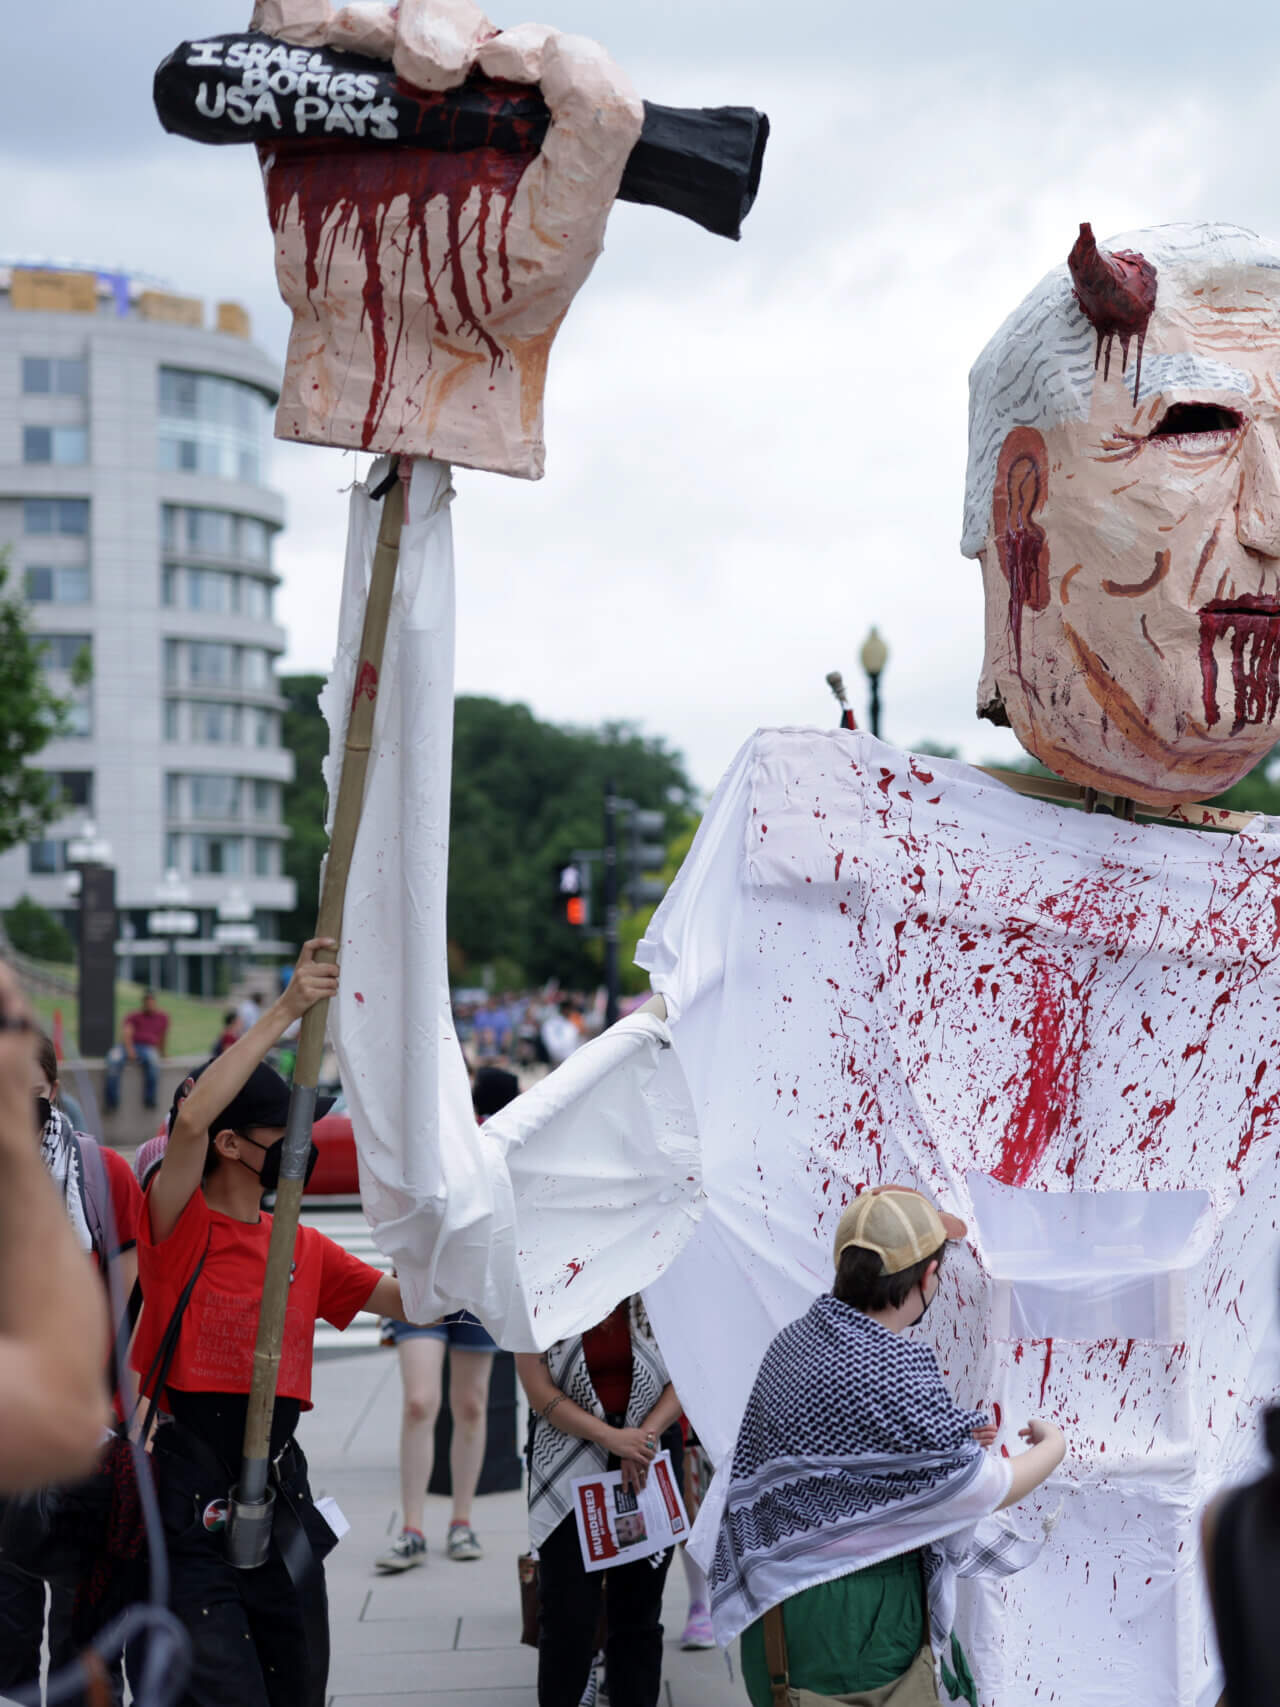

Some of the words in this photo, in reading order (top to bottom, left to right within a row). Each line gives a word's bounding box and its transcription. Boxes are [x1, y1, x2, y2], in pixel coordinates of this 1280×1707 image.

[186, 43, 333, 74] ISRAEL
[242, 69, 379, 101] BOMBS
[195, 82, 283, 129] USA
[193, 1349, 240, 1368] SPRING
[584, 1490, 604, 1556] MURDERED
